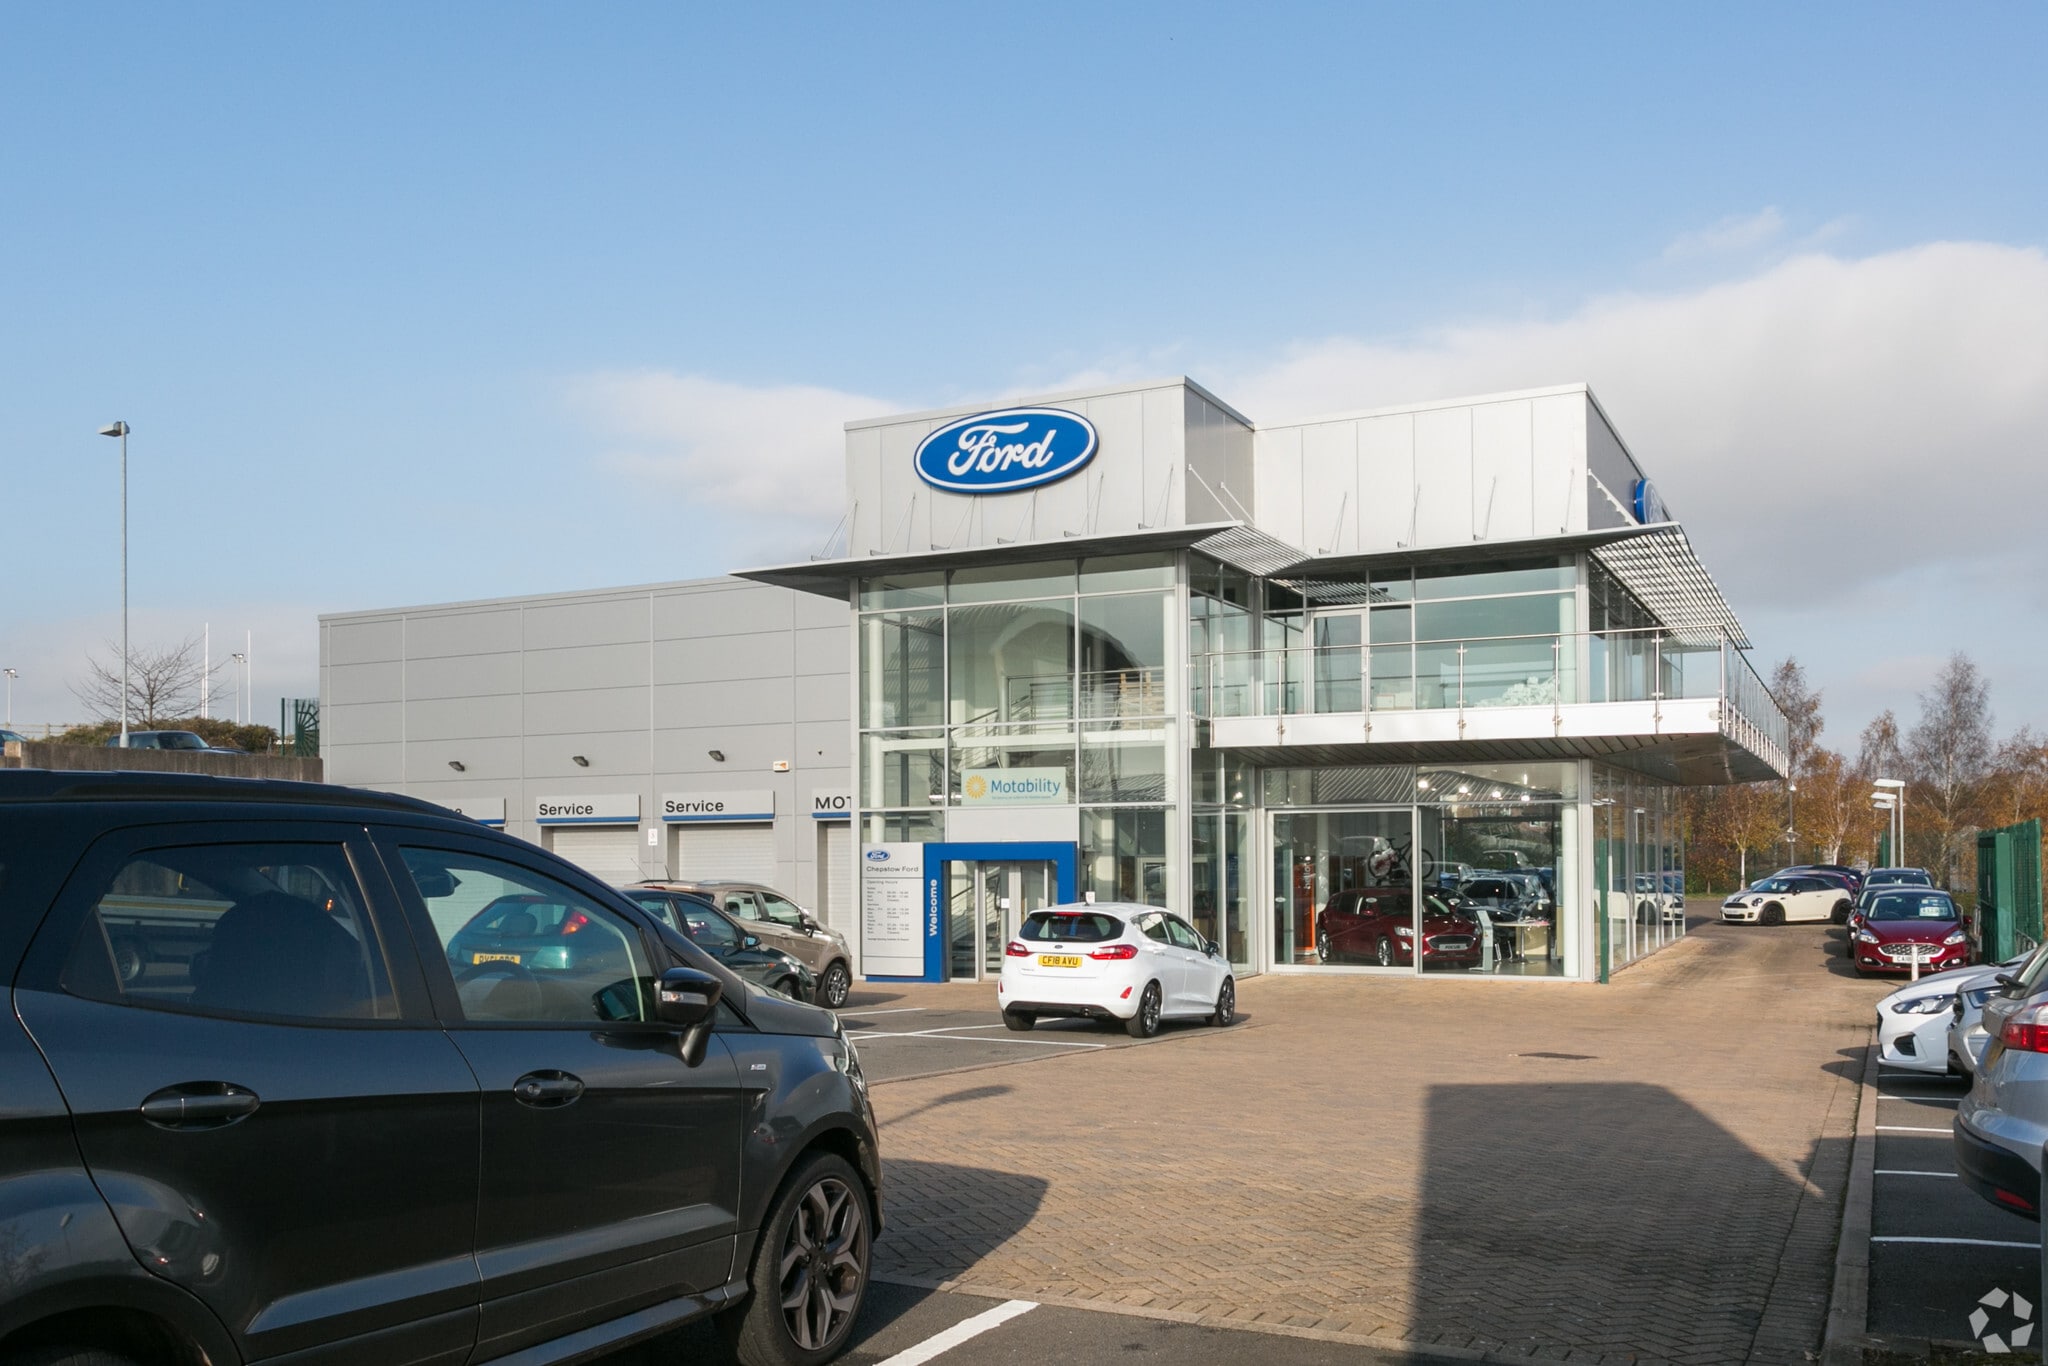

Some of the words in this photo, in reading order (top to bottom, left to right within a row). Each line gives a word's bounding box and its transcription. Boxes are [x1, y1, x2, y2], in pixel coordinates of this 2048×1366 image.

[947, 421, 1057, 476] Ford
[991, 778, 1061, 796] Motability
[539, 803, 594, 816] Service
[665, 799, 724, 813] Service
[866, 865, 900, 873] Chepstow
[929, 879, 938, 936] Welcome
[1042, 956, 1060, 965] CF18
[1062, 957, 1078, 966] AVU
